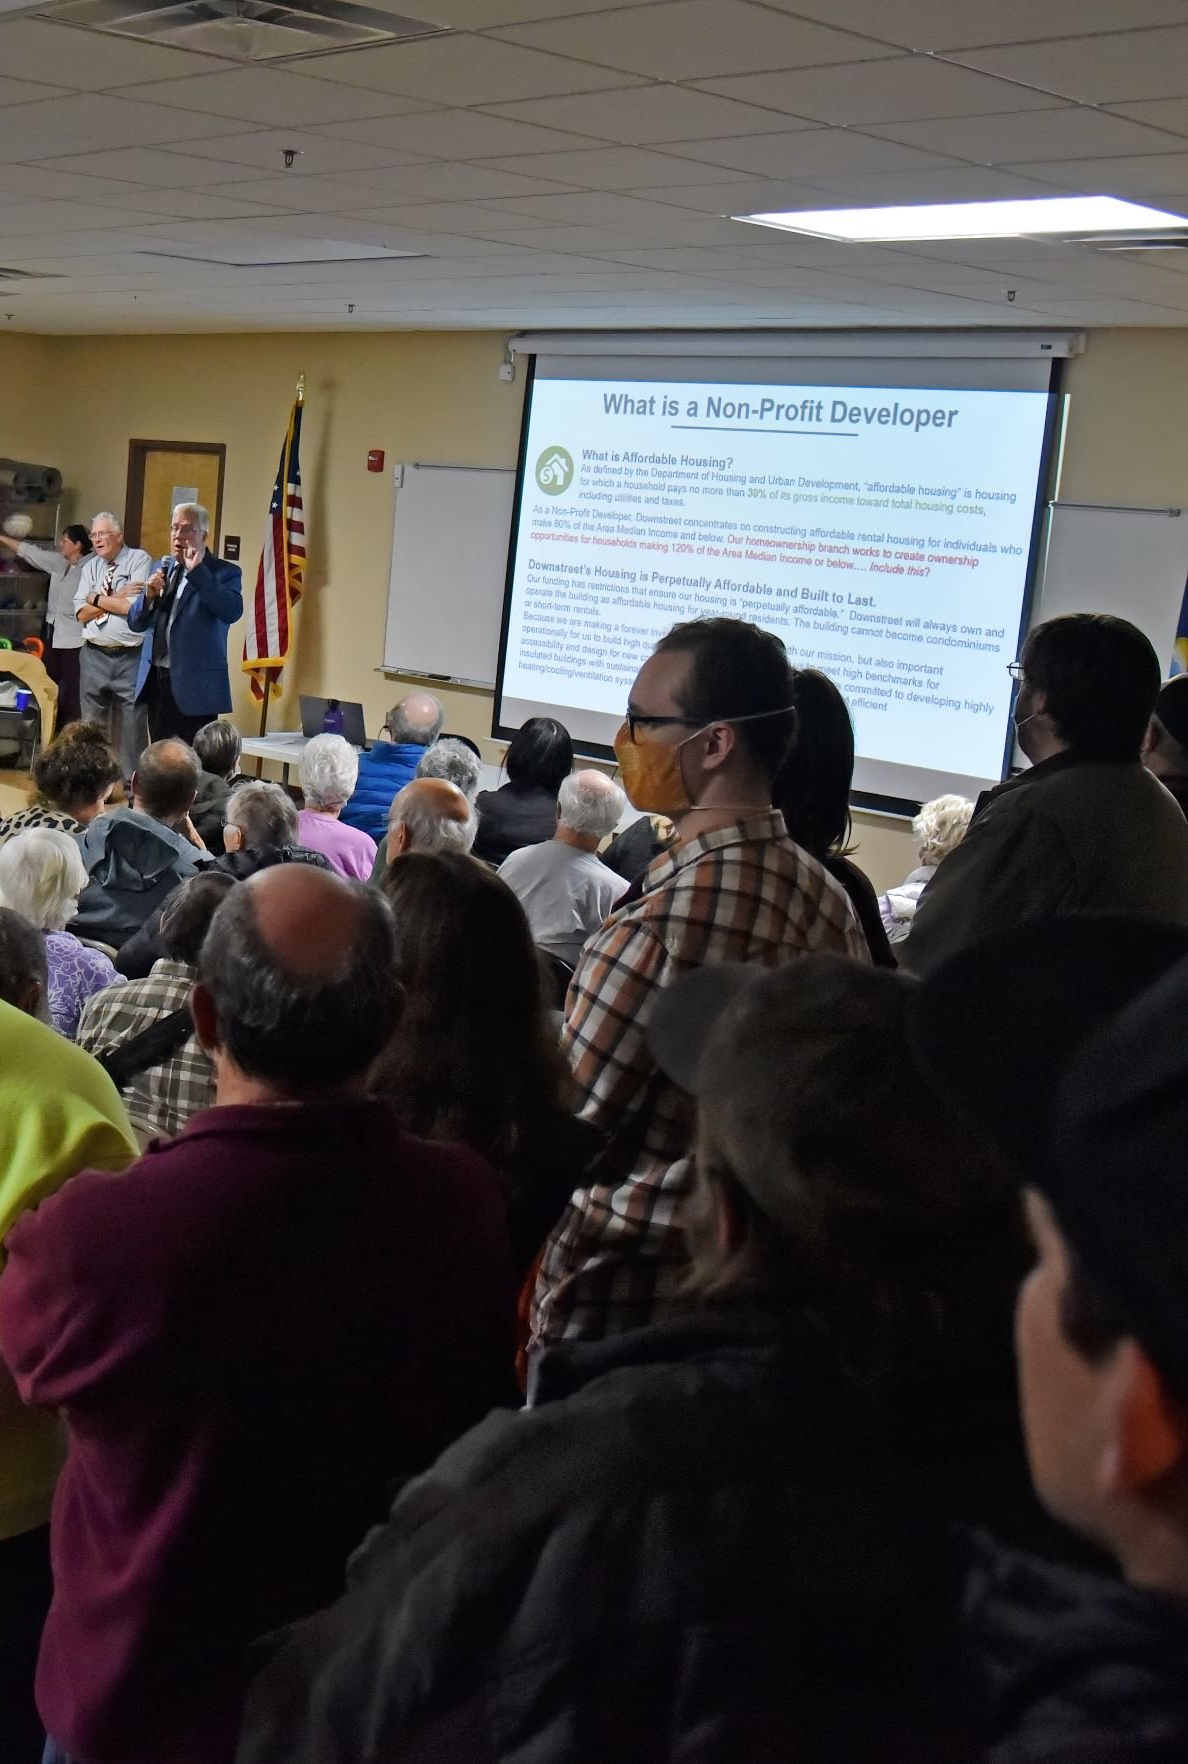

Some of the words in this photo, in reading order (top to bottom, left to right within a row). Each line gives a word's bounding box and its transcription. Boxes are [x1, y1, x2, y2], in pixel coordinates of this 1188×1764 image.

[603, 392, 657, 416] What
[661, 394, 680, 417] is
[686, 400, 699, 418] a
[705, 395, 824, 423] Non-Profit
[829, 399, 959, 433] Developer
[582, 448, 609, 461] What
[610, 450, 620, 462] is
[622, 450, 678, 466] Affordable
[679, 453, 734, 471] Housing?
[580, 463, 591, 473] As
[593, 463, 623, 476] defined
[623, 465, 635, 478] by
[635, 466, 649, 477] the
[650, 467, 700, 481] Department
[700, 470, 710, 481] of
[710, 471, 747, 486] Housing
[748, 474, 766, 485] and
[767, 474, 796, 487] Urban
[963, 487, 972, 499] is
[974, 488, 1017, 505] housing
[531, 518, 553, 528] make
[553, 518, 571, 529] 80%
[572, 520, 581, 531] of
[581, 520, 595, 532] the
[595, 522, 615, 534] Area
[616, 523, 646, 537] Median
[647, 526, 679, 540] Income
[679, 530, 697, 541] and
[727, 533, 744, 546] Our
[744, 535, 816, 554] homeownership
[817, 541, 850, 555] branch
[852, 544, 881, 558] works
[882, 548, 893, 560] to
[893, 550, 925, 562] create
[927, 554, 979, 570] ownership
[532, 504, 543, 514] As
[551, 505, 590, 518] Non-Profit
[635, 511, 682, 526] Downstreet
[683, 518, 738, 531] concentrates
[738, 523, 751, 532] on
[752, 523, 807, 539] constructing
[808, 527, 855, 541] affordable
[856, 532, 885, 544] rental
[885, 532, 926, 550] housing
[926, 536, 941, 549] for
[943, 537, 998, 554] individuals
[999, 543, 1023, 556] who
[580, 533, 591, 544] for
[638, 540, 668, 554] making
[671, 542, 694, 554] 120%
[695, 545, 705, 555] of
[706, 545, 720, 556] the
[721, 546, 743, 559] Area
[744, 549, 777, 562] Median
[779, 552, 812, 566] Income
[814, 558, 824, 567] or
[869, 561, 904, 575] Include
[906, 564, 931, 578] this?
[594, 565, 637, 583] Housing
[639, 569, 649, 582] is
[651, 571, 712, 591] Perpetually
[713, 578, 773, 596] Affordable
[775, 586, 799, 599] and
[800, 587, 829, 602] Built
[831, 591, 844, 605] to
[846, 592, 877, 608] Last.
